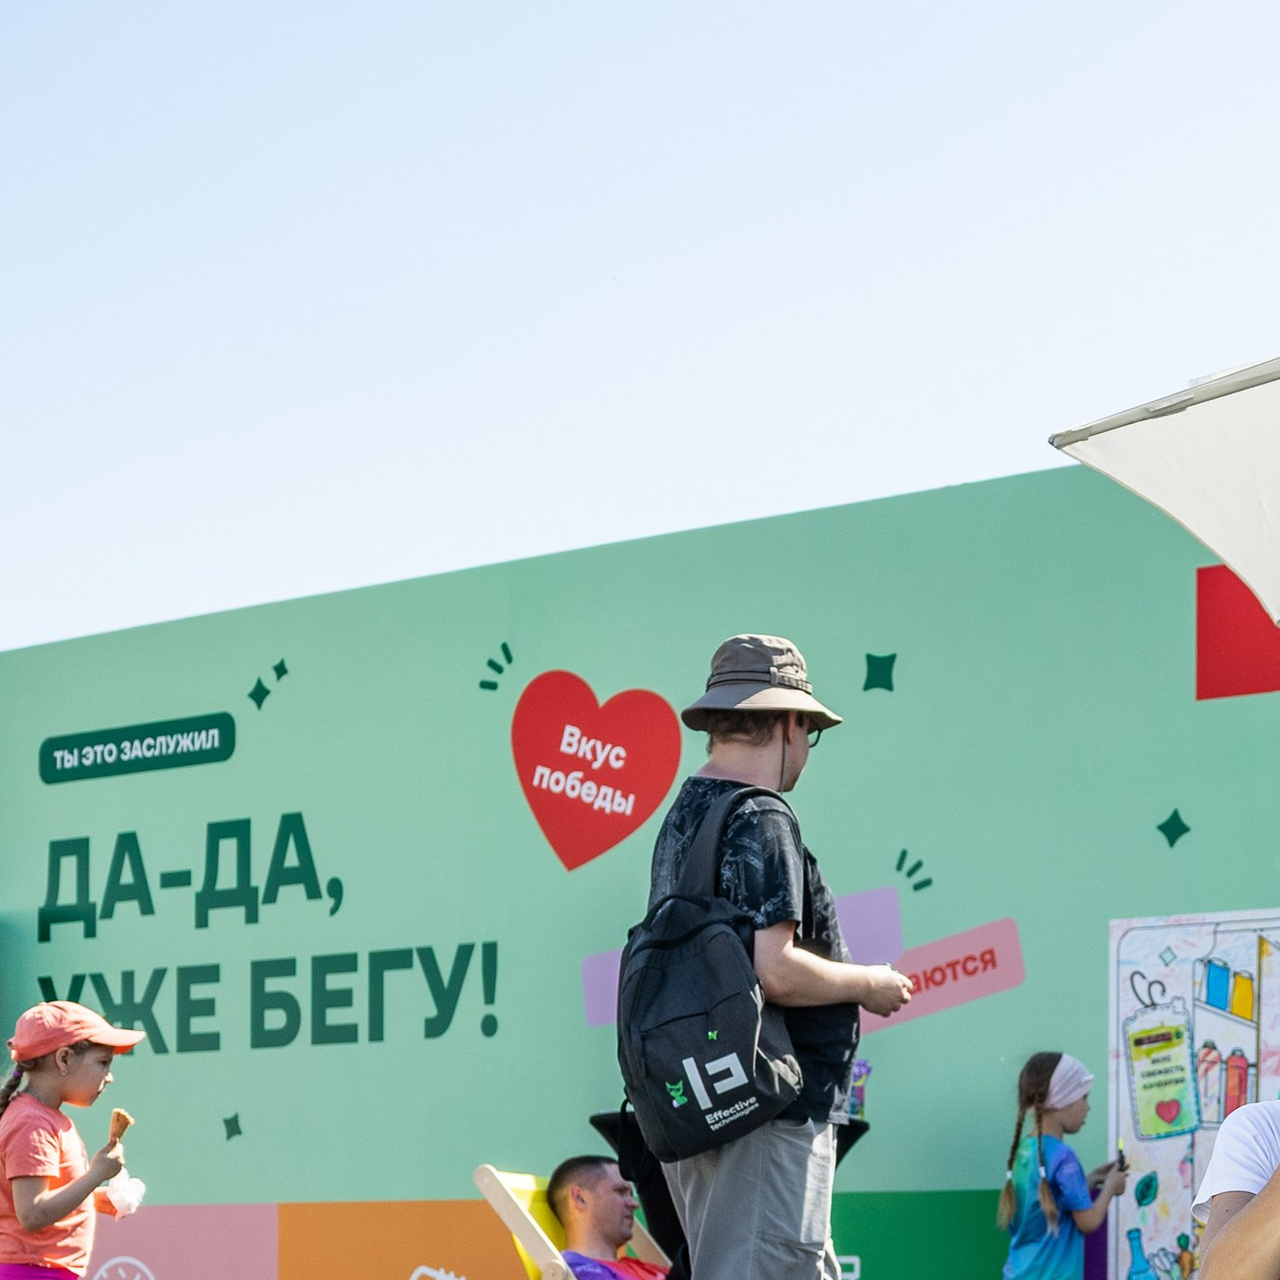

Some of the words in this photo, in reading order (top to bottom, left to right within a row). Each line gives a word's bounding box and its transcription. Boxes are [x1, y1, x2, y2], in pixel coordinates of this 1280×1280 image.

[53, 748, 79, 770] ТЫ
[82, 741, 118, 767] ЭТО
[119, 727, 220, 762] ЗАСЛУЖИЛ
[559, 725, 627, 770] Вкус
[532, 765, 636, 816] победы
[37, 811, 344, 943] ДА-ДА,
[906, 947, 998, 997] аются
[250, 941, 500, 1051] БЕГУ!
[705, 1096, 757, 1125] Effective
[709, 1102, 760, 1132] technologies
